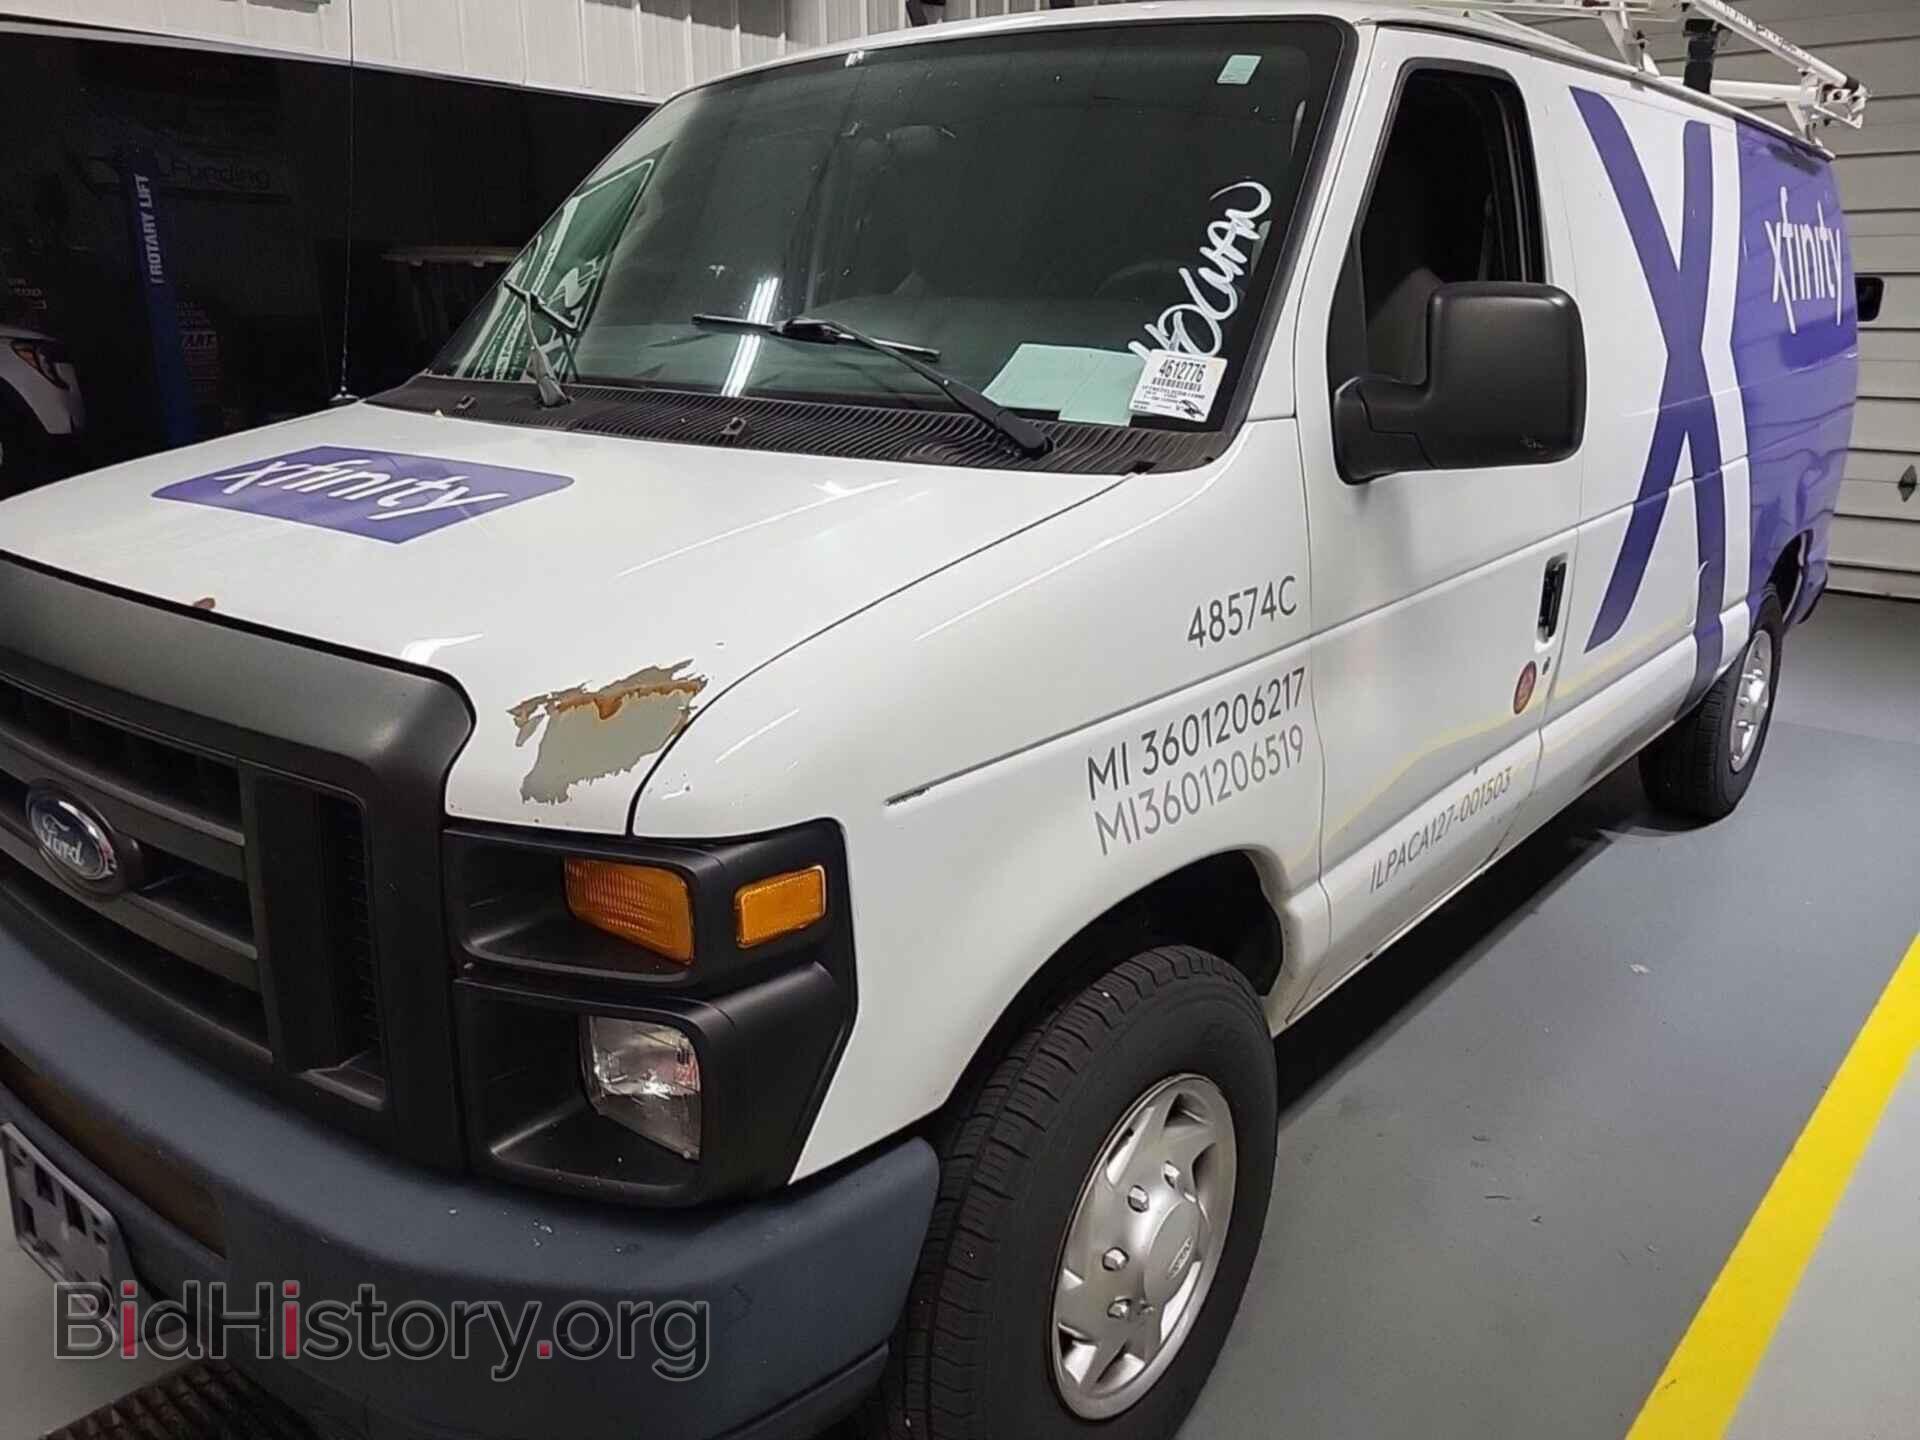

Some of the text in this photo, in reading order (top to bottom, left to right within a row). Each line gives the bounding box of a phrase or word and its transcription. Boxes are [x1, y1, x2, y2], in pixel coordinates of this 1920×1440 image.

[134, 173, 164, 275] ROTARY LIFT
[1765, 187, 1842, 333] xfinity
[215, 459, 508, 520] xfinity
[1187, 576, 1297, 648] 48574C
[1087, 667, 1305, 801] MI 3601206217
[42, 814, 85, 866] Ford
[1095, 724, 1303, 856] MI3601206519
